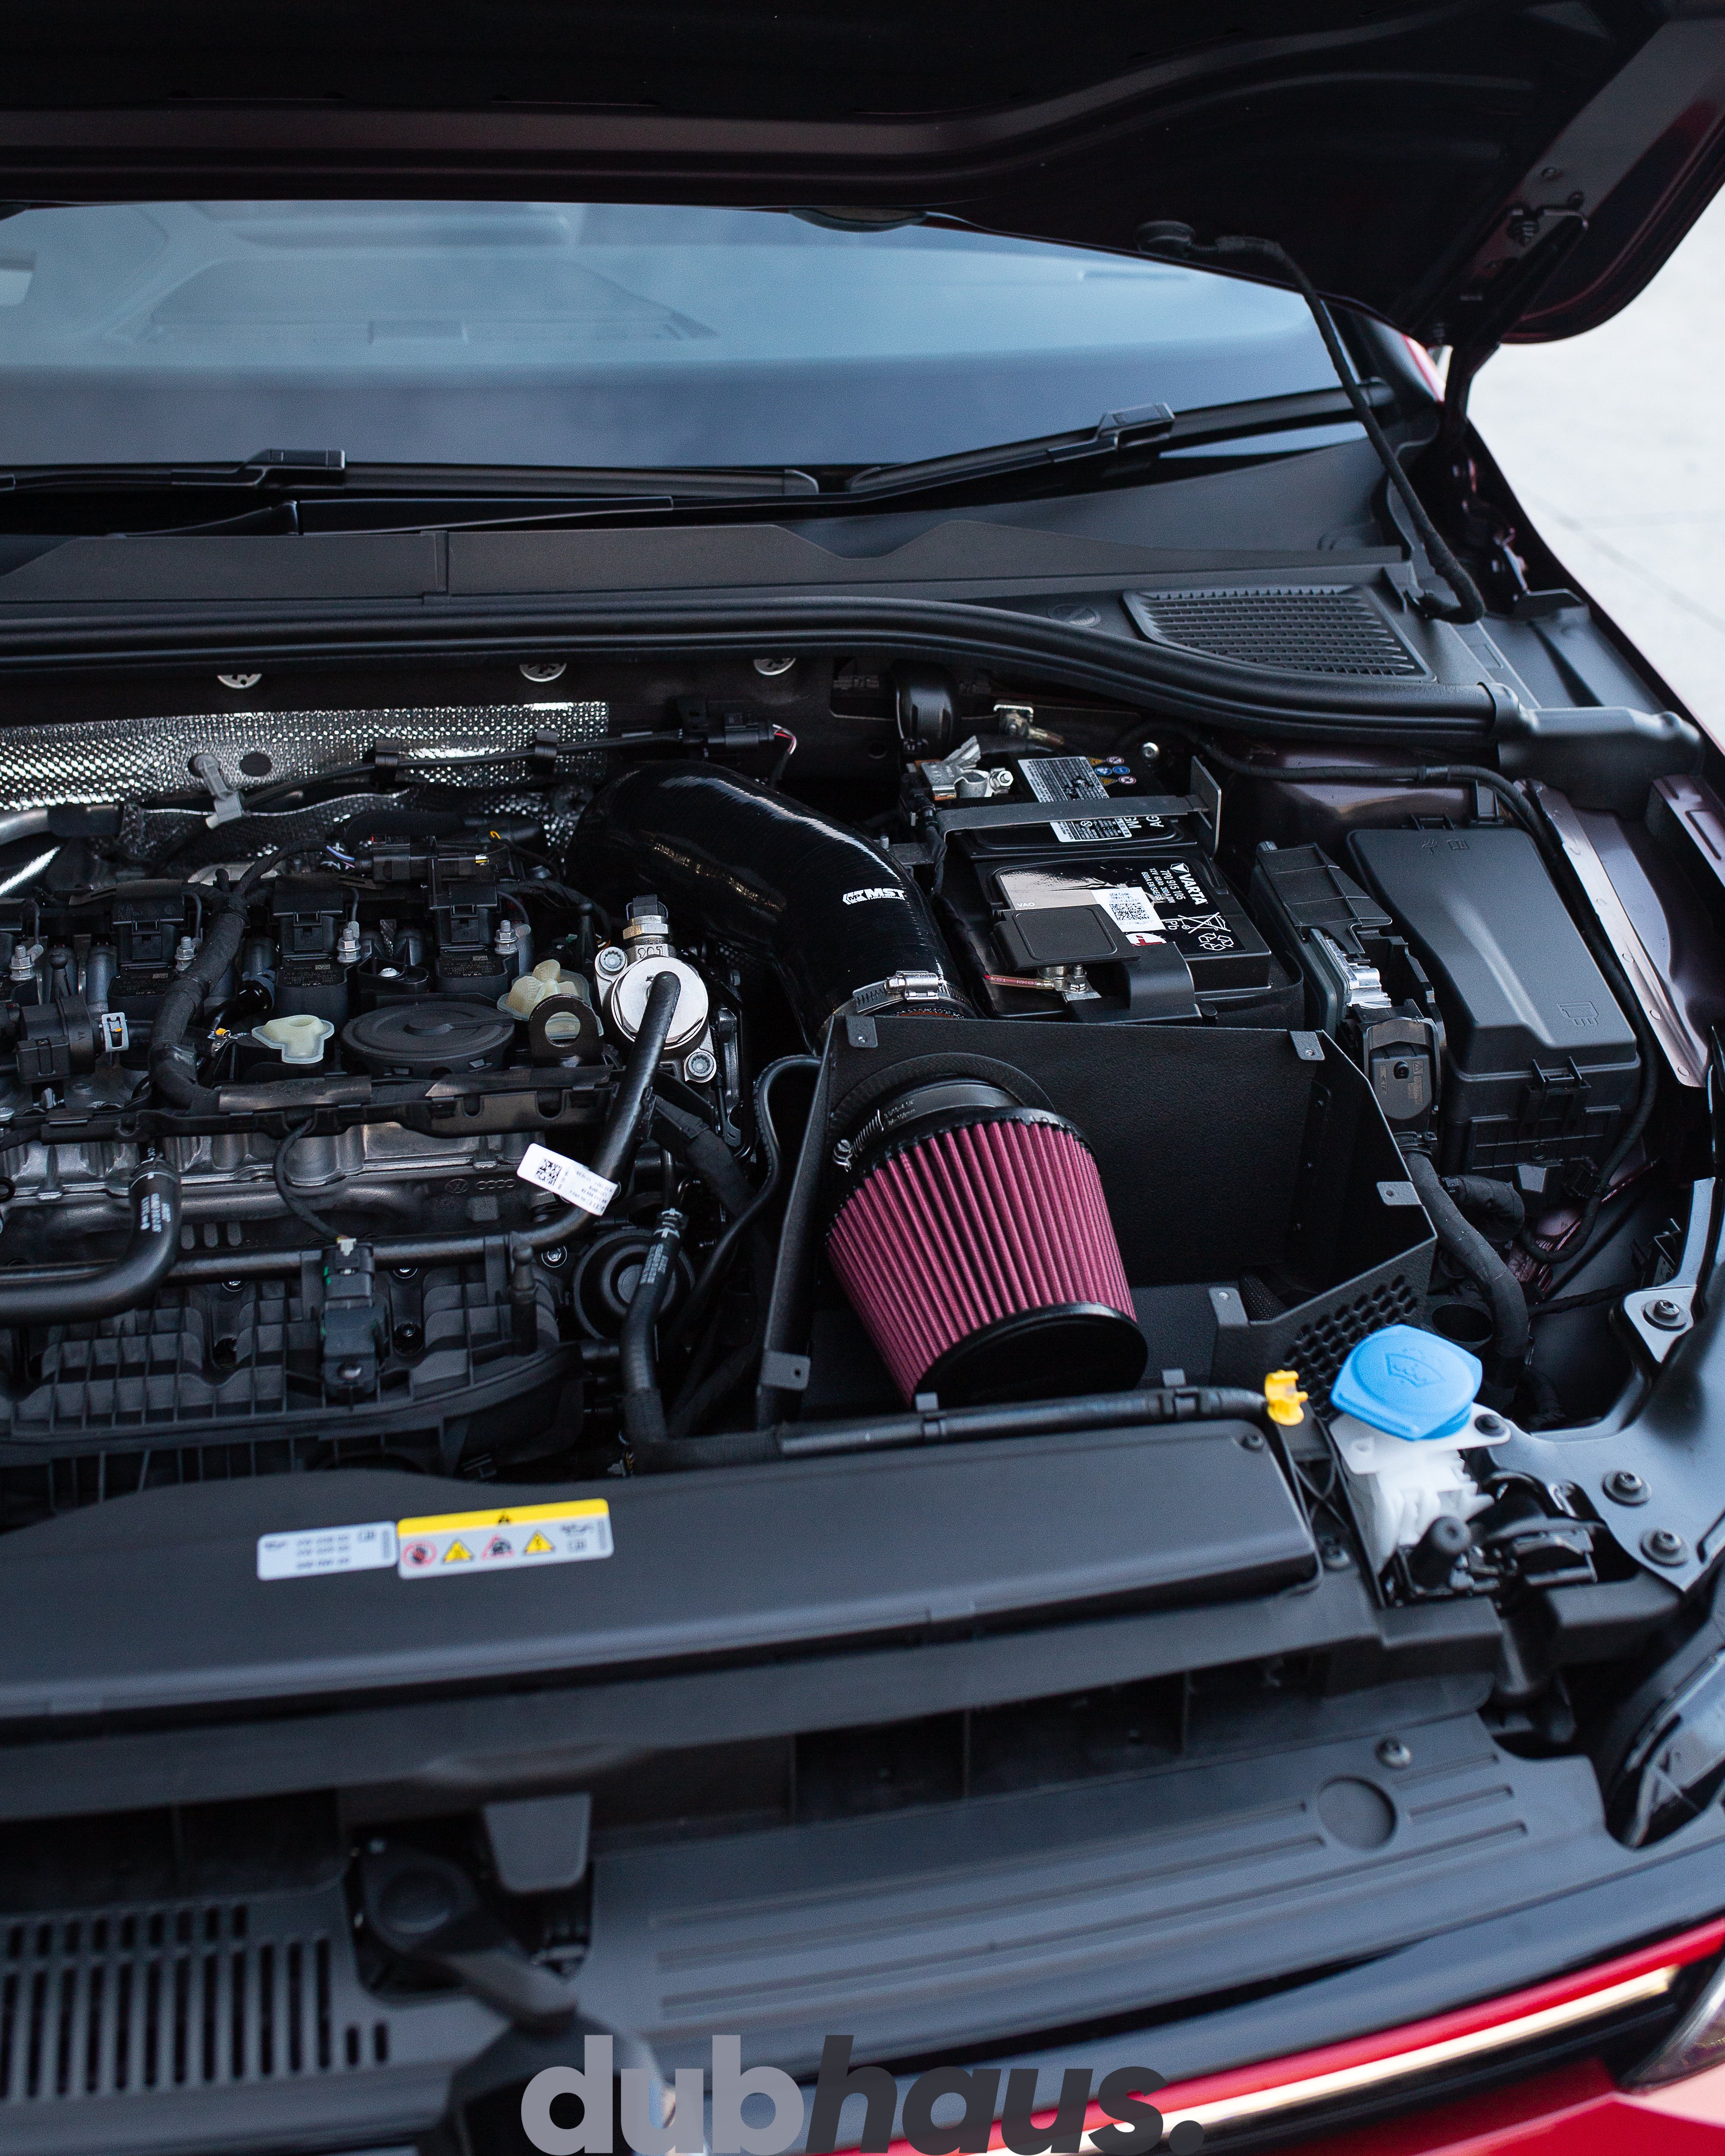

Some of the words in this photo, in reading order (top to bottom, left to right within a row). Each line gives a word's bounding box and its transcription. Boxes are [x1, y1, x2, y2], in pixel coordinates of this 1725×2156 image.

[1123, 817, 1141, 828] GM
[1146, 815, 1164, 827] AG
[1160, 869, 1173, 879] 7P0
[1167, 880, 1179, 890] 915
[1173, 889, 1186, 900] 105
[1179, 874, 1208, 905] VARTA
[864, 888, 905, 899] MST
[1165, 921, 1180, 930] Pb
